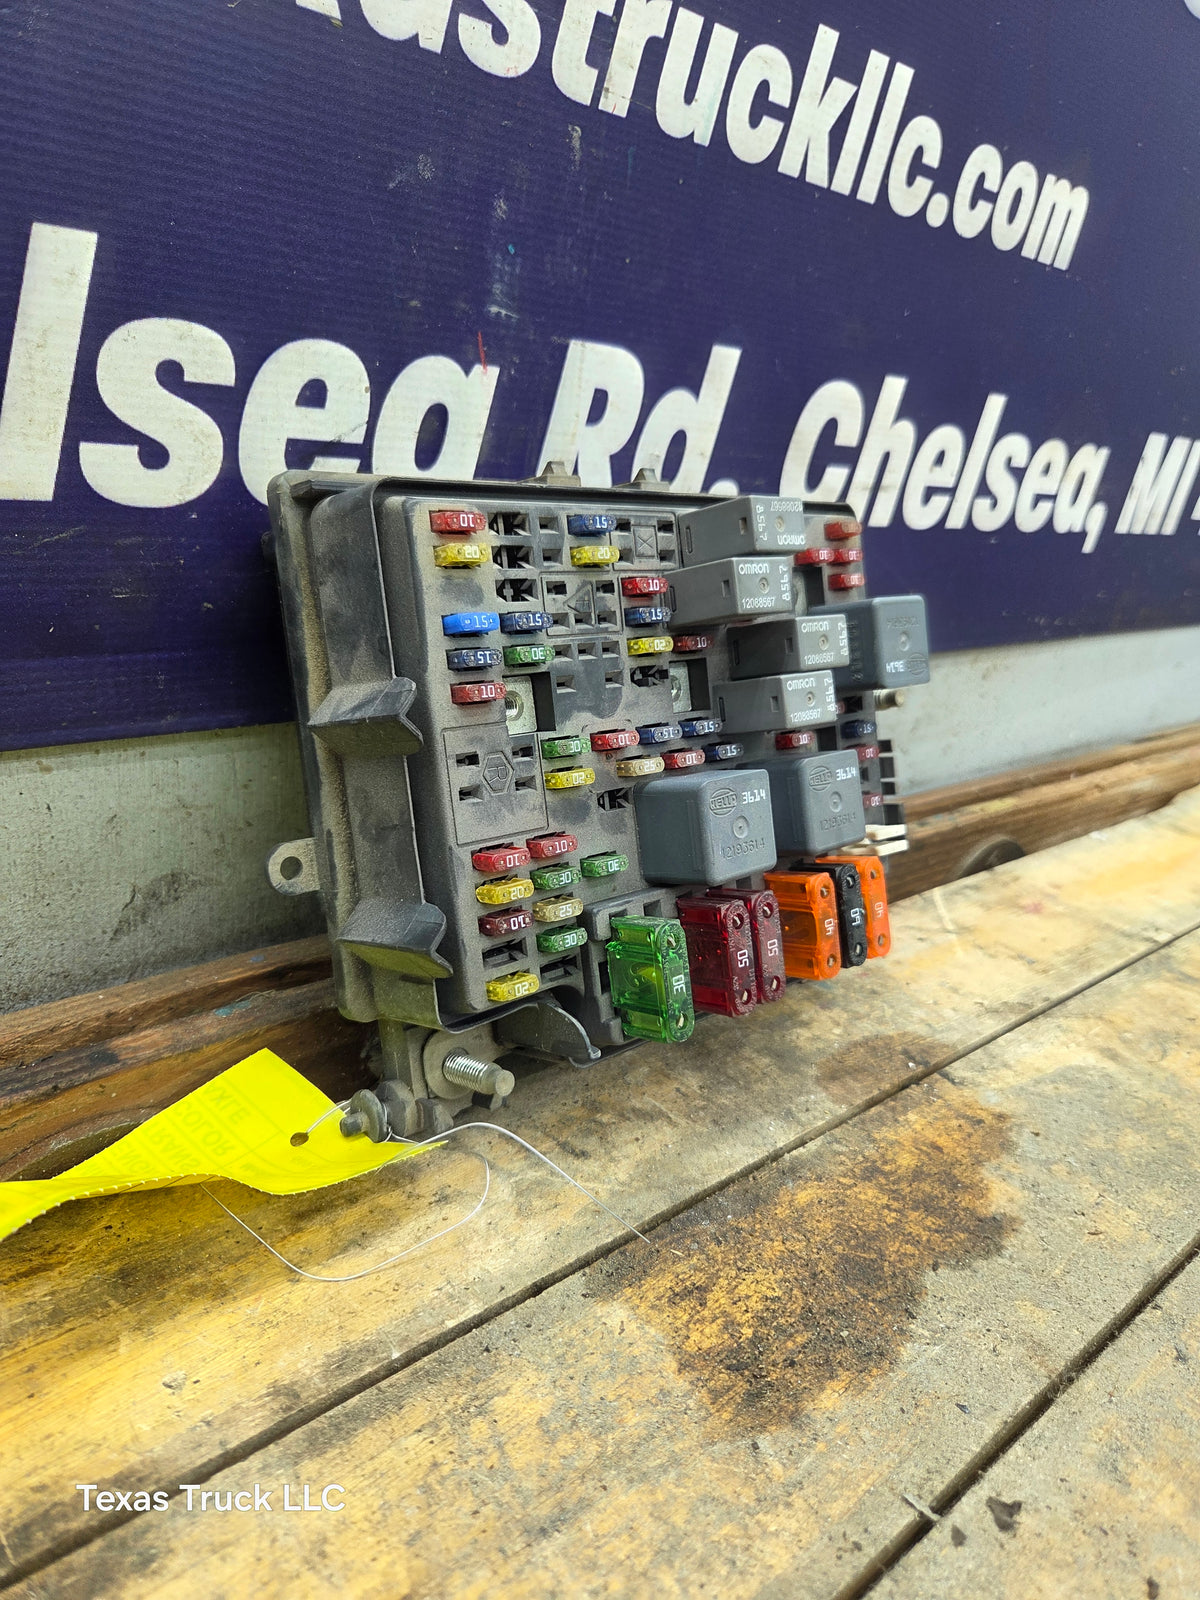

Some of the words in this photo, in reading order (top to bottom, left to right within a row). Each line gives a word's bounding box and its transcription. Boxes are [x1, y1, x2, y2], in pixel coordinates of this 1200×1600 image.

[778, 373, 1112, 553] Chelsea,
[460, 514, 474, 527] 10
[596, 516, 608, 528] 15
[756, 504, 768, 541] 8567
[463, 546, 479, 558] 20
[598, 547, 610, 559] 20
[819, 551, 828, 560] 10
[849, 551, 857, 560] 10
[648, 580, 660, 591] 10
[779, 565, 791, 601] 8567
[528, 614, 542, 626] 15
[651, 609, 663, 620] 15
[474, 616, 488, 628] 15
[654, 639, 666, 651] 20
[697, 637, 707, 648] 10
[838, 622, 848, 656] 8567
[478, 652, 492, 664] 15
[532, 648, 546, 660] 30
[886, 661, 905, 672] 3614
[481, 686, 495, 698] 10
[824, 677, 836, 712] 8567
[664, 727, 674, 738] 15
[704, 722, 715, 732] 15
[864, 724, 872, 733] 15
[618, 734, 630, 745] 10
[799, 734, 808, 745] 10
[570, 740, 580, 753] 30
[727, 745, 737, 756] 15
[686, 754, 696, 764] 10
[866, 748, 874, 758] 10
[644, 761, 656, 772] 25
[572, 772, 585, 784] 20
[836, 767, 856, 780] 3614
[742, 789, 766, 804] 3614
[555, 840, 568, 853] 10
[506, 854, 520, 868] 10
[608, 859, 620, 871] 30
[558, 871, 572, 885] 30
[510, 886, 524, 900] 20
[559, 904, 572, 917] 25
[874, 901, 884, 918] 40
[511, 915, 525, 930] 10
[850, 908, 861, 926] 60
[824, 918, 834, 936] 40
[564, 933, 577, 947] 30
[767, 938, 778, 956] 50
[738, 950, 749, 968] 50
[515, 981, 529, 996] 20
[673, 974, 686, 994] 30
